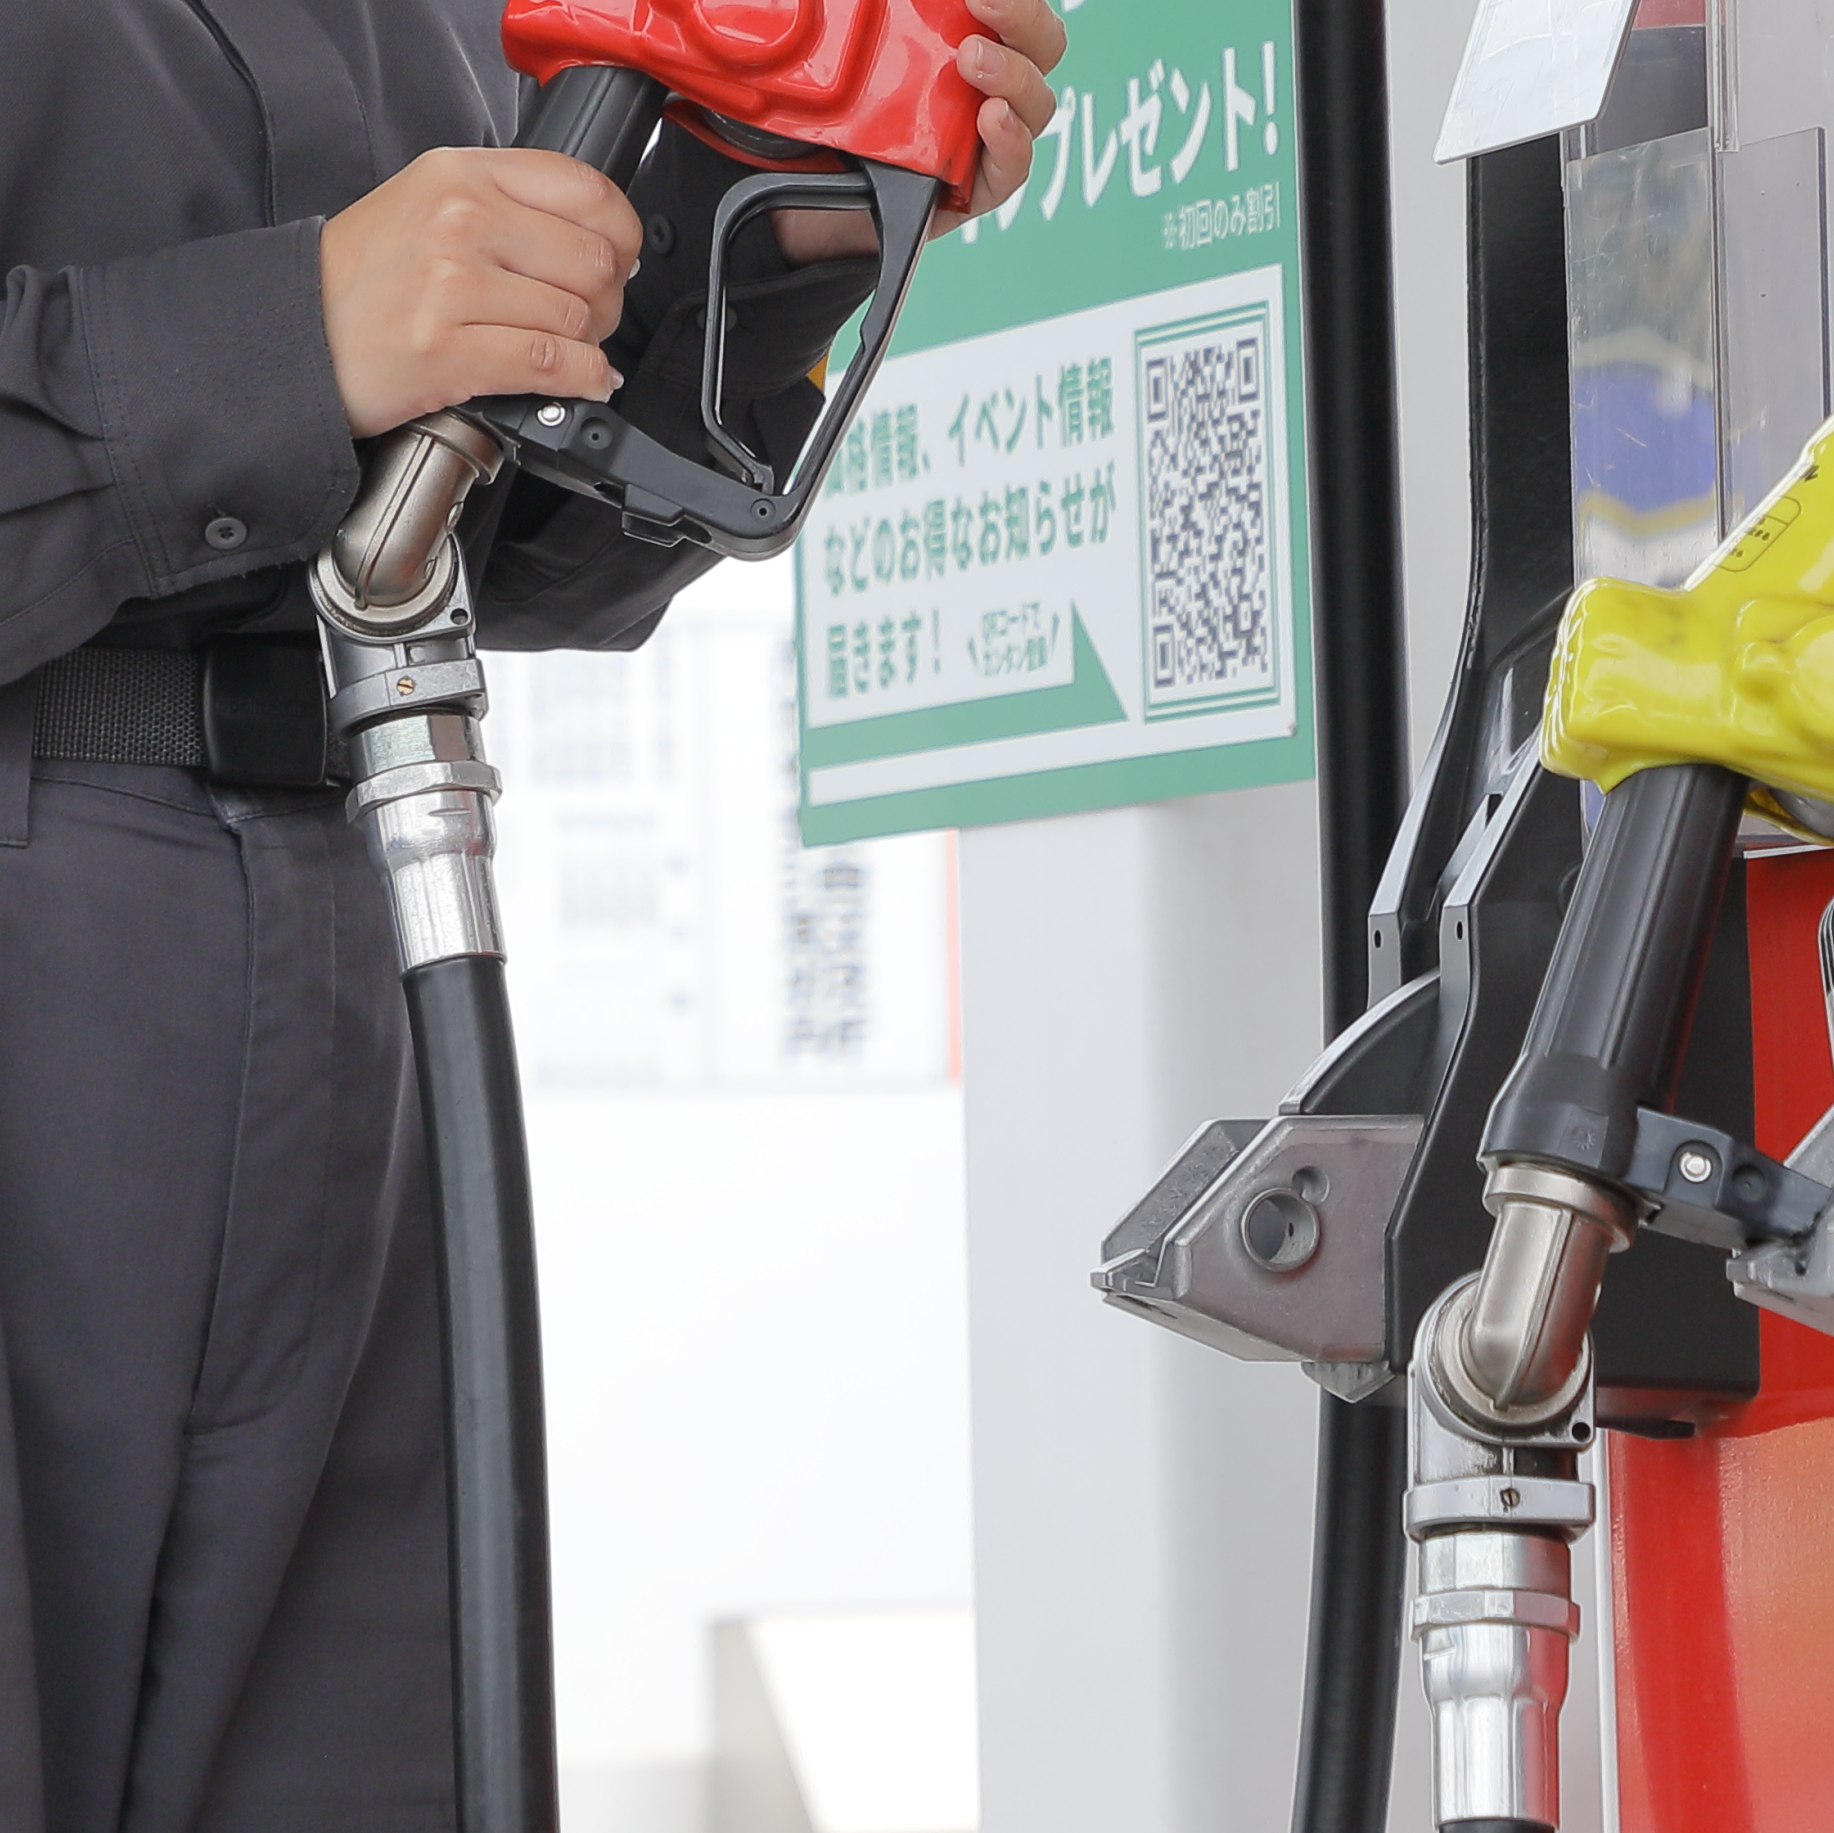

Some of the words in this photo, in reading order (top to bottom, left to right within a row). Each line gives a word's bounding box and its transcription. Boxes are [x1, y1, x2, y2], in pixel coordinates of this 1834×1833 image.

[962, 40, 1280, 244] プレゼント!
[824, 460, 1116, 597] などのお得なお知らせが
